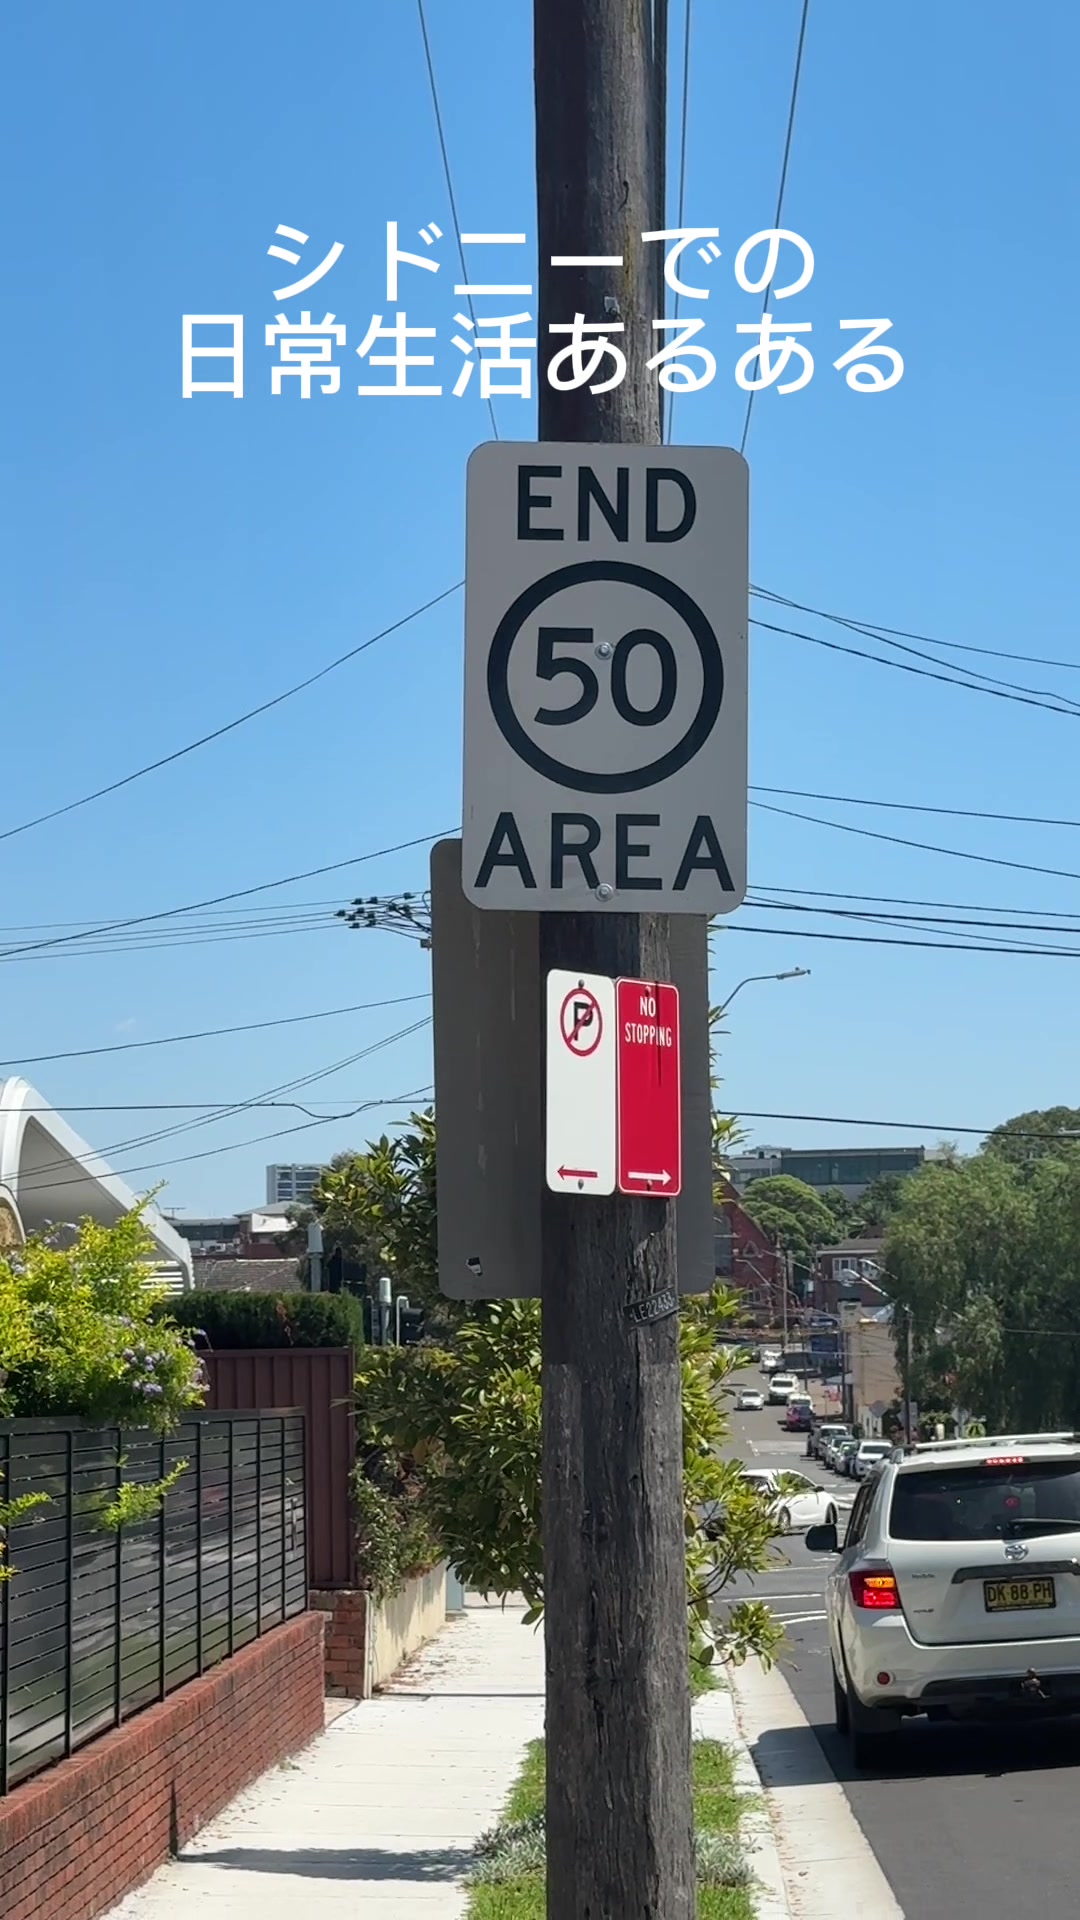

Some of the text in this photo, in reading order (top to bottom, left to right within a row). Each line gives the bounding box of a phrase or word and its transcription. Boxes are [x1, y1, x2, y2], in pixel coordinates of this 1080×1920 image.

[517, 465, 697, 543] END
[534, 627, 677, 726] 50
[474, 812, 735, 891] AREA
[573, 1001, 594, 1041] P
[624, 1022, 672, 1048] STOPPING
[639, 996, 656, 1018] NO
